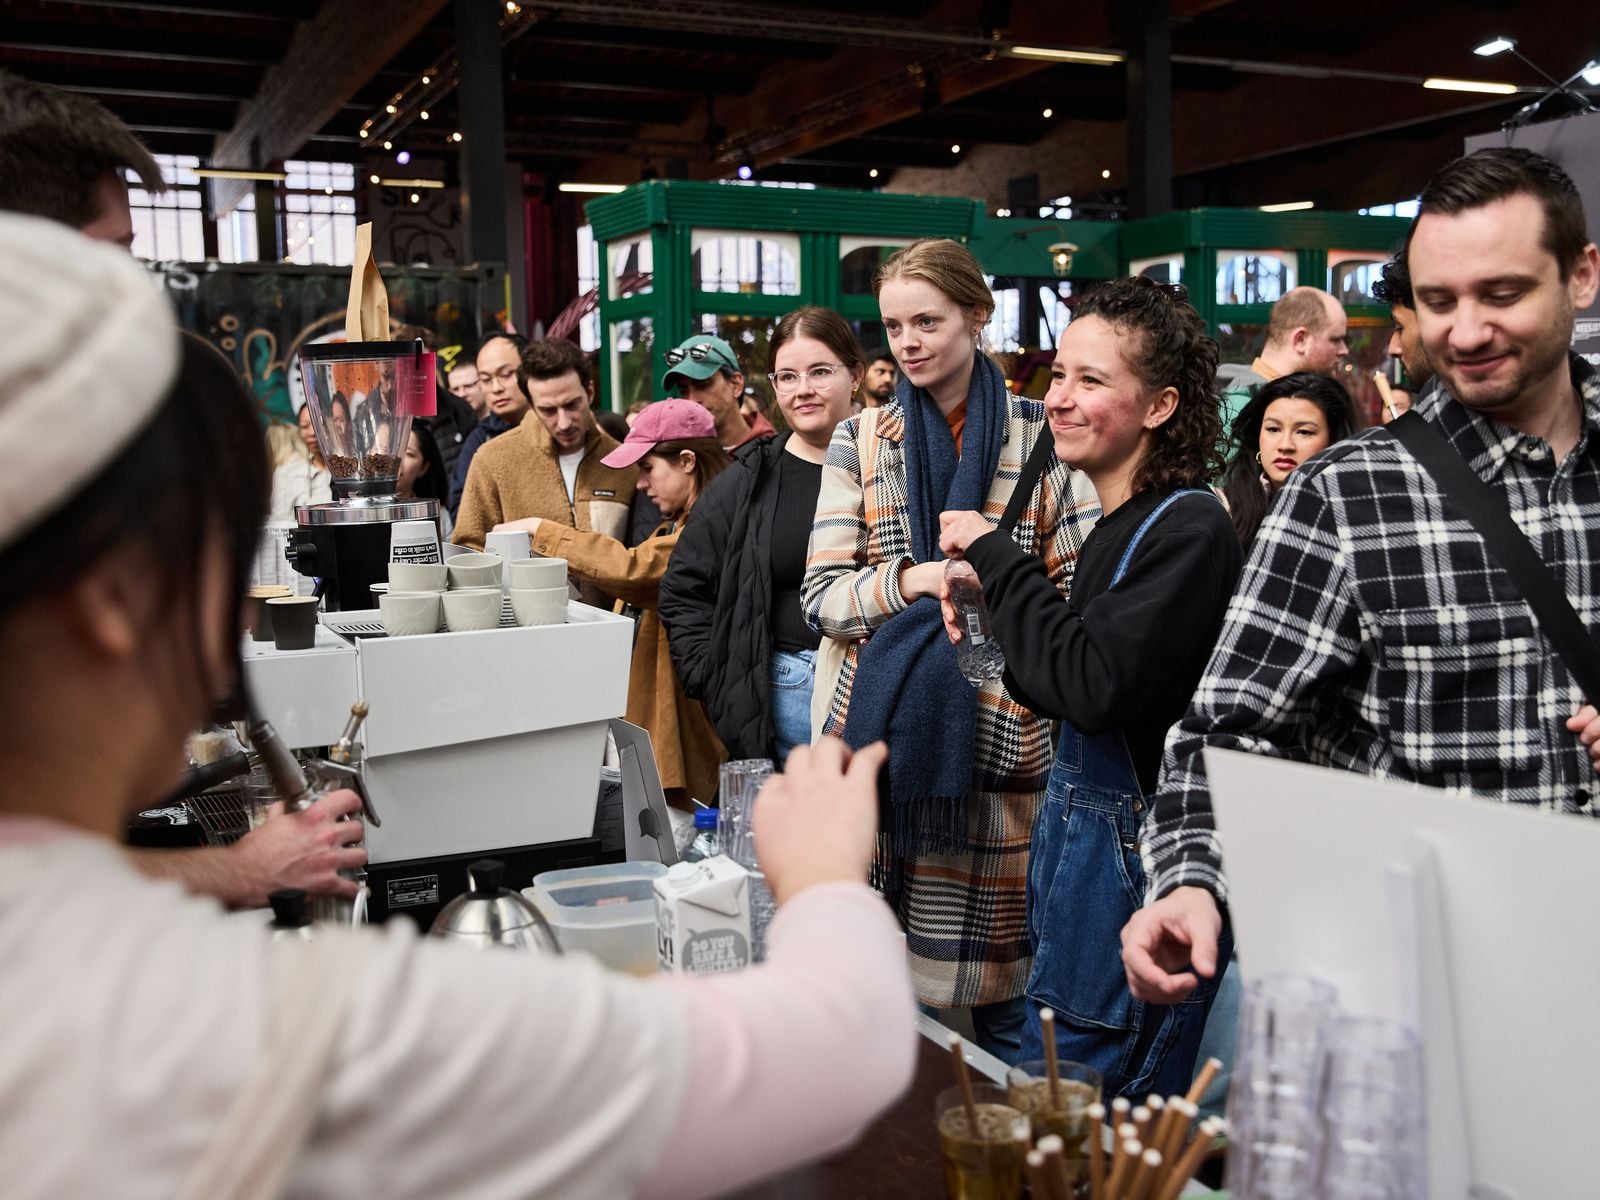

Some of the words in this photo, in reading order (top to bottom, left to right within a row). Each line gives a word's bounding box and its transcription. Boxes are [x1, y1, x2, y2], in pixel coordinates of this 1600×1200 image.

[691, 939, 708, 953] DO
[709, 935, 734, 949] YOU
[691, 949, 725, 964] HAVE
[727, 947, 737, 959] A
